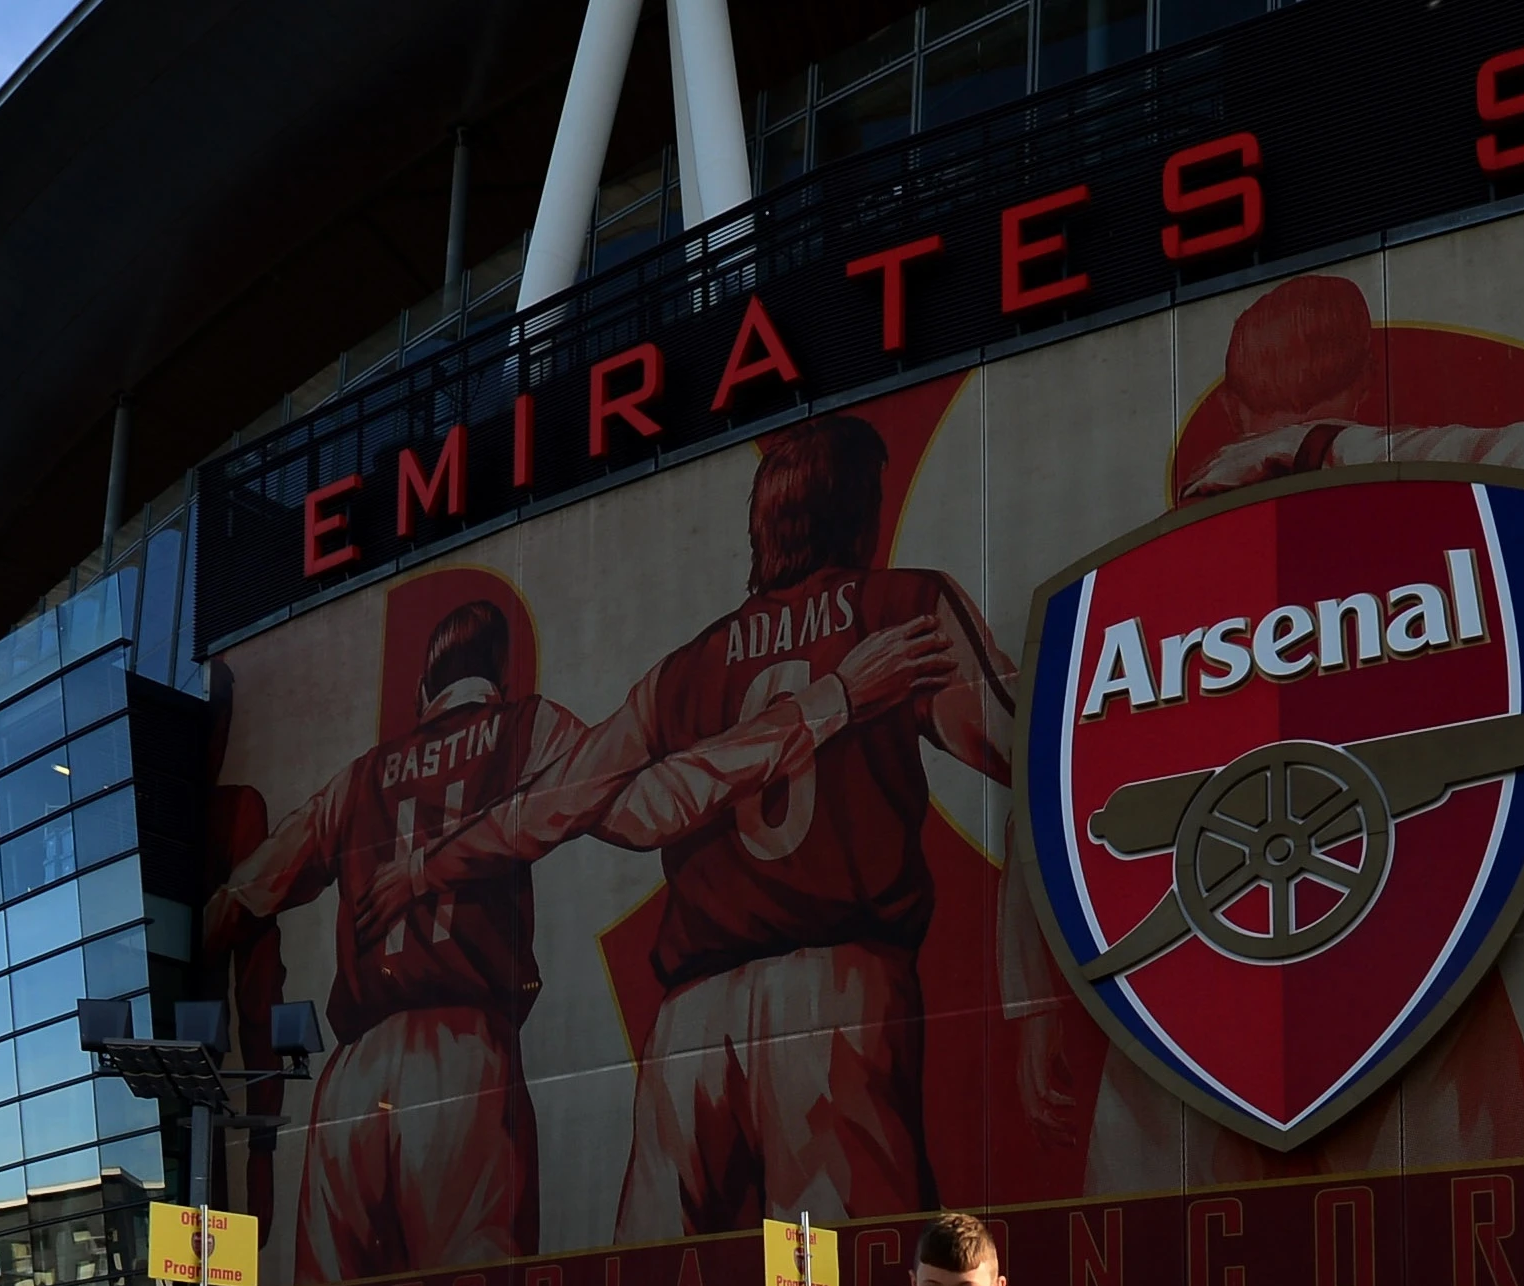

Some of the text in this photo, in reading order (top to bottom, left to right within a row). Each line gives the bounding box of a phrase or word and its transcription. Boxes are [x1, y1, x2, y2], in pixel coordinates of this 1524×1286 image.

[302, 131, 1266, 579] EMIRATES
[725, 581, 857, 667] ADAMS
[1080, 547, 1489, 721] Arsenal
[382, 713, 501, 789] BASTIN
